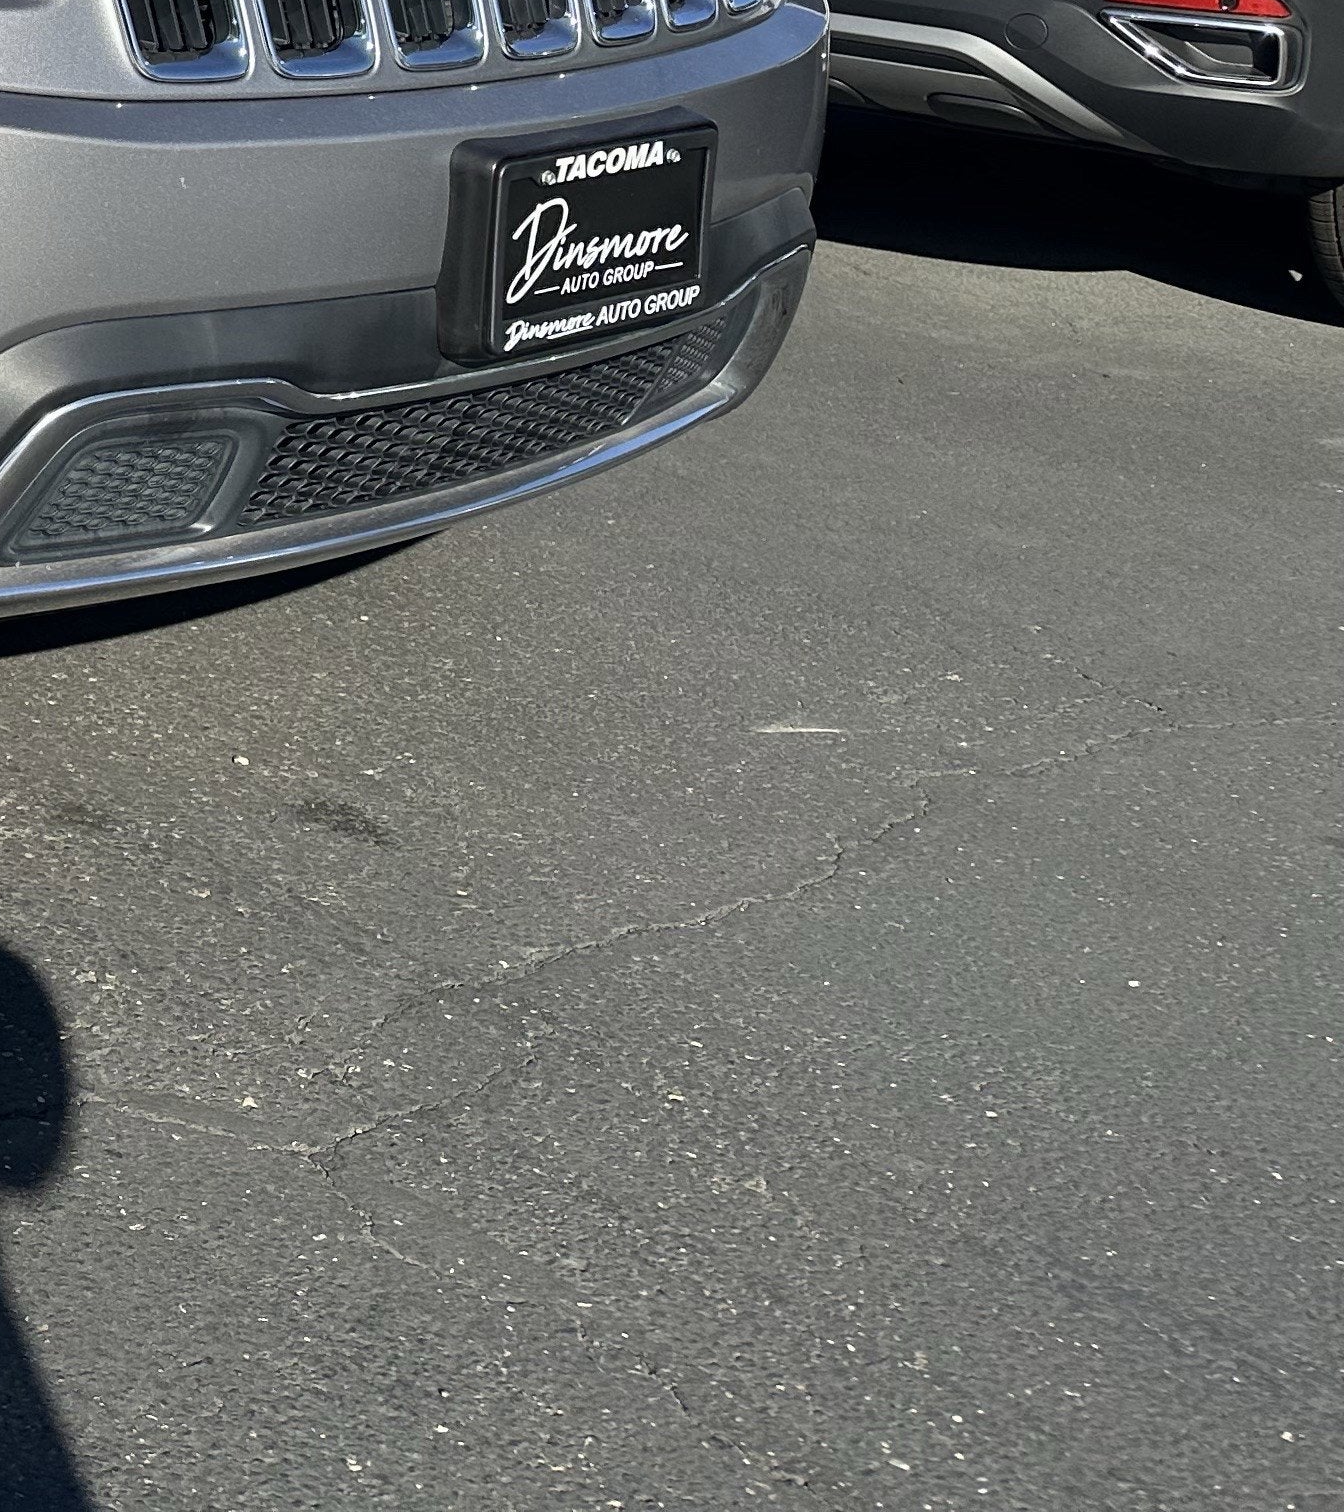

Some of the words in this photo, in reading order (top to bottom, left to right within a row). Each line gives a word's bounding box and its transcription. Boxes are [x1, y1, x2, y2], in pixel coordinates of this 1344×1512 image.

[555, 141, 664, 184] TACOMA
[505, 197, 689, 305] Dinsmore
[560, 270, 600, 295] AUTO
[603, 260, 655, 286] GROUP
[503, 311, 596, 352] Dinsmore
[595, 299, 641, 326] AUTO
[643, 285, 701, 316] GROUP
